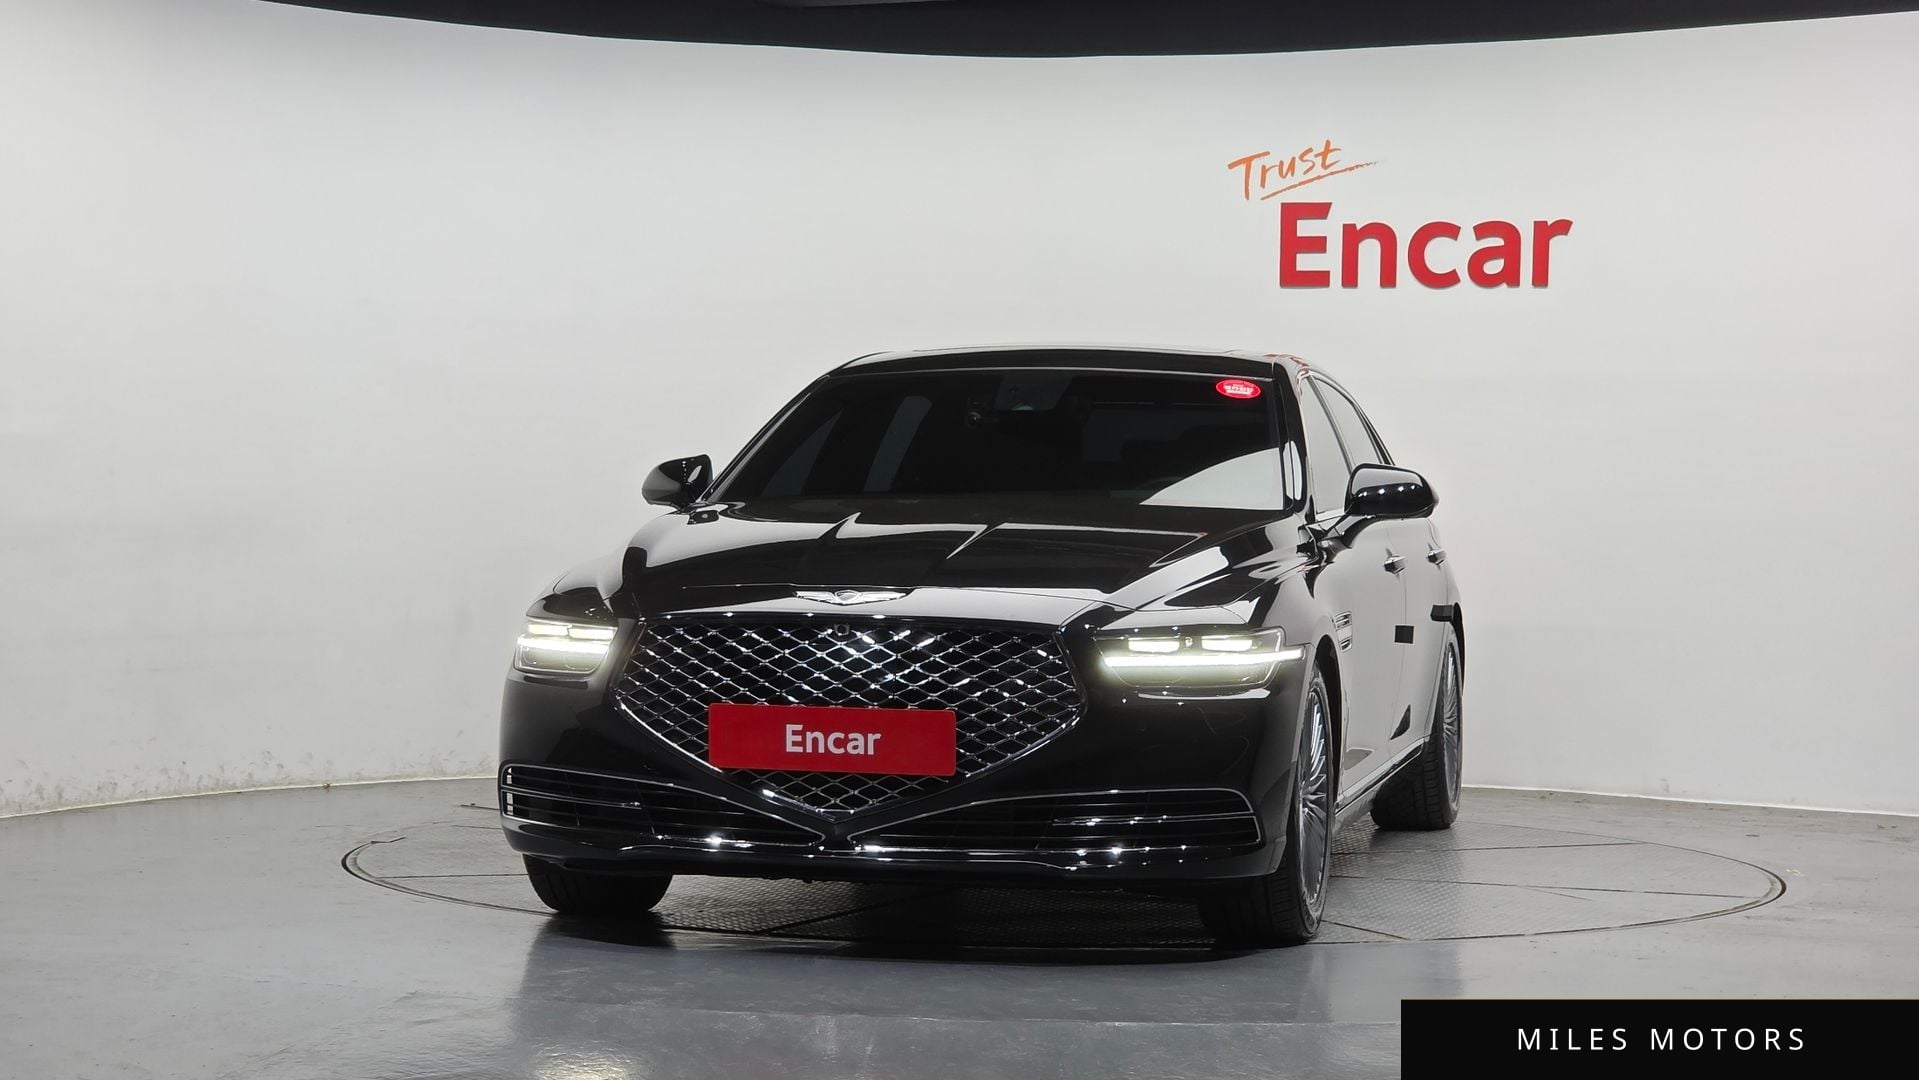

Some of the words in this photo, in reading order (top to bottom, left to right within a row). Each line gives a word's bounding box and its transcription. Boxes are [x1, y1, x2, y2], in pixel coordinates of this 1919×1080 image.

[1227, 139, 1342, 200] Trust
[1279, 202, 1573, 288] Encar
[785, 724, 881, 755] Encar
